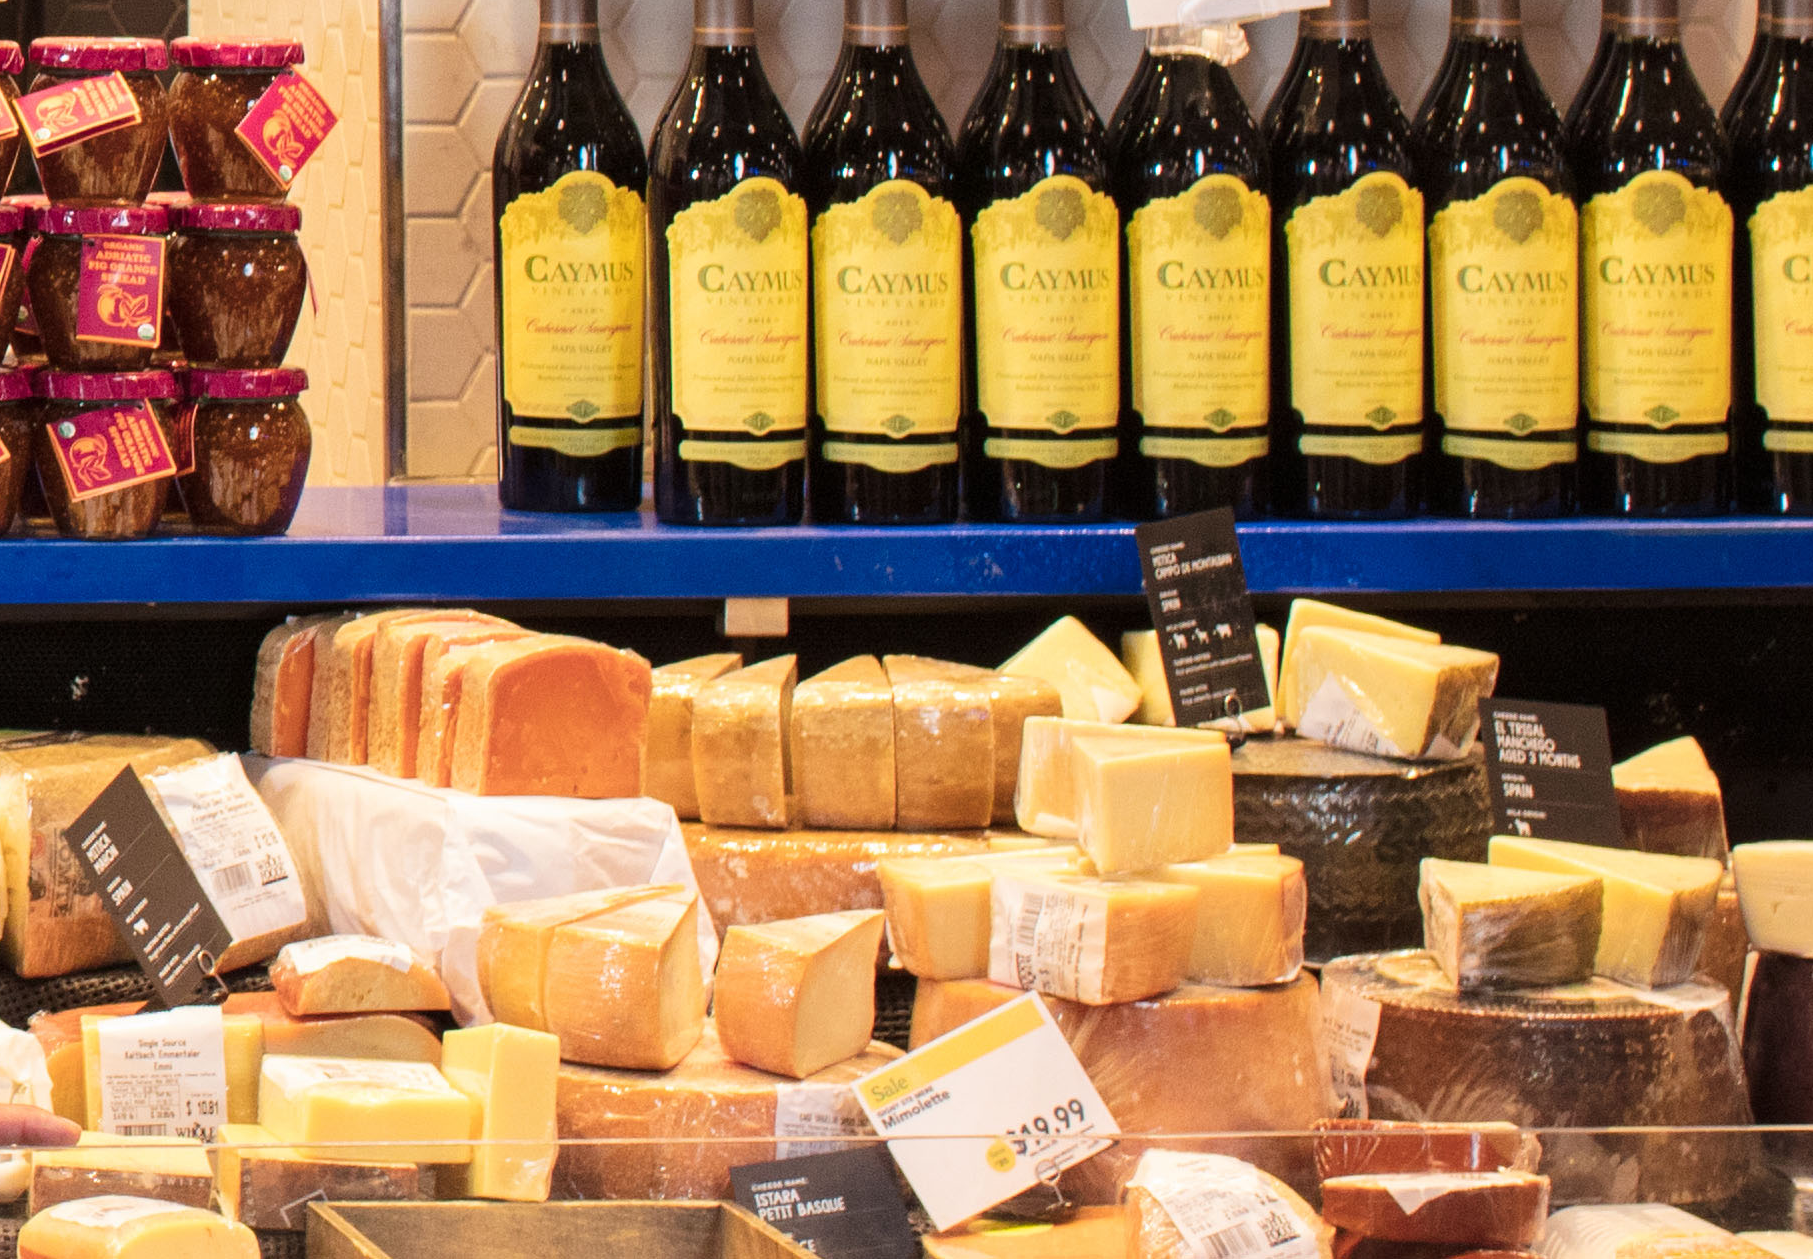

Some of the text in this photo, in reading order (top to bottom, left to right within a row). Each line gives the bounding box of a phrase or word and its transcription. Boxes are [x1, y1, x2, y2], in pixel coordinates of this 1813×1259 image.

[95, 250, 151, 263] ADRIATIC
[103, 241, 145, 252] ORGANIC
[88, 261, 157, 276] FIG ORANGE
[101, 272, 146, 285] SPREAD
[524, 252, 634, 284] CAYMUS
[836, 262, 949, 294] CAYMUS
[1000, 259, 1110, 291] CAYMUS
[1155, 257, 1264, 289] CAYMUS
[1457, 262, 1567, 293] CAYMUS
[1598, 254, 1714, 286] CAYMUS
[871, 1075, 909, 1102] Sale
[881, 1090, 951, 1130] Mimolette
[754, 1188, 800, 1208] ISTARA
[758, 1196, 847, 1222] PETIT BASQUE
